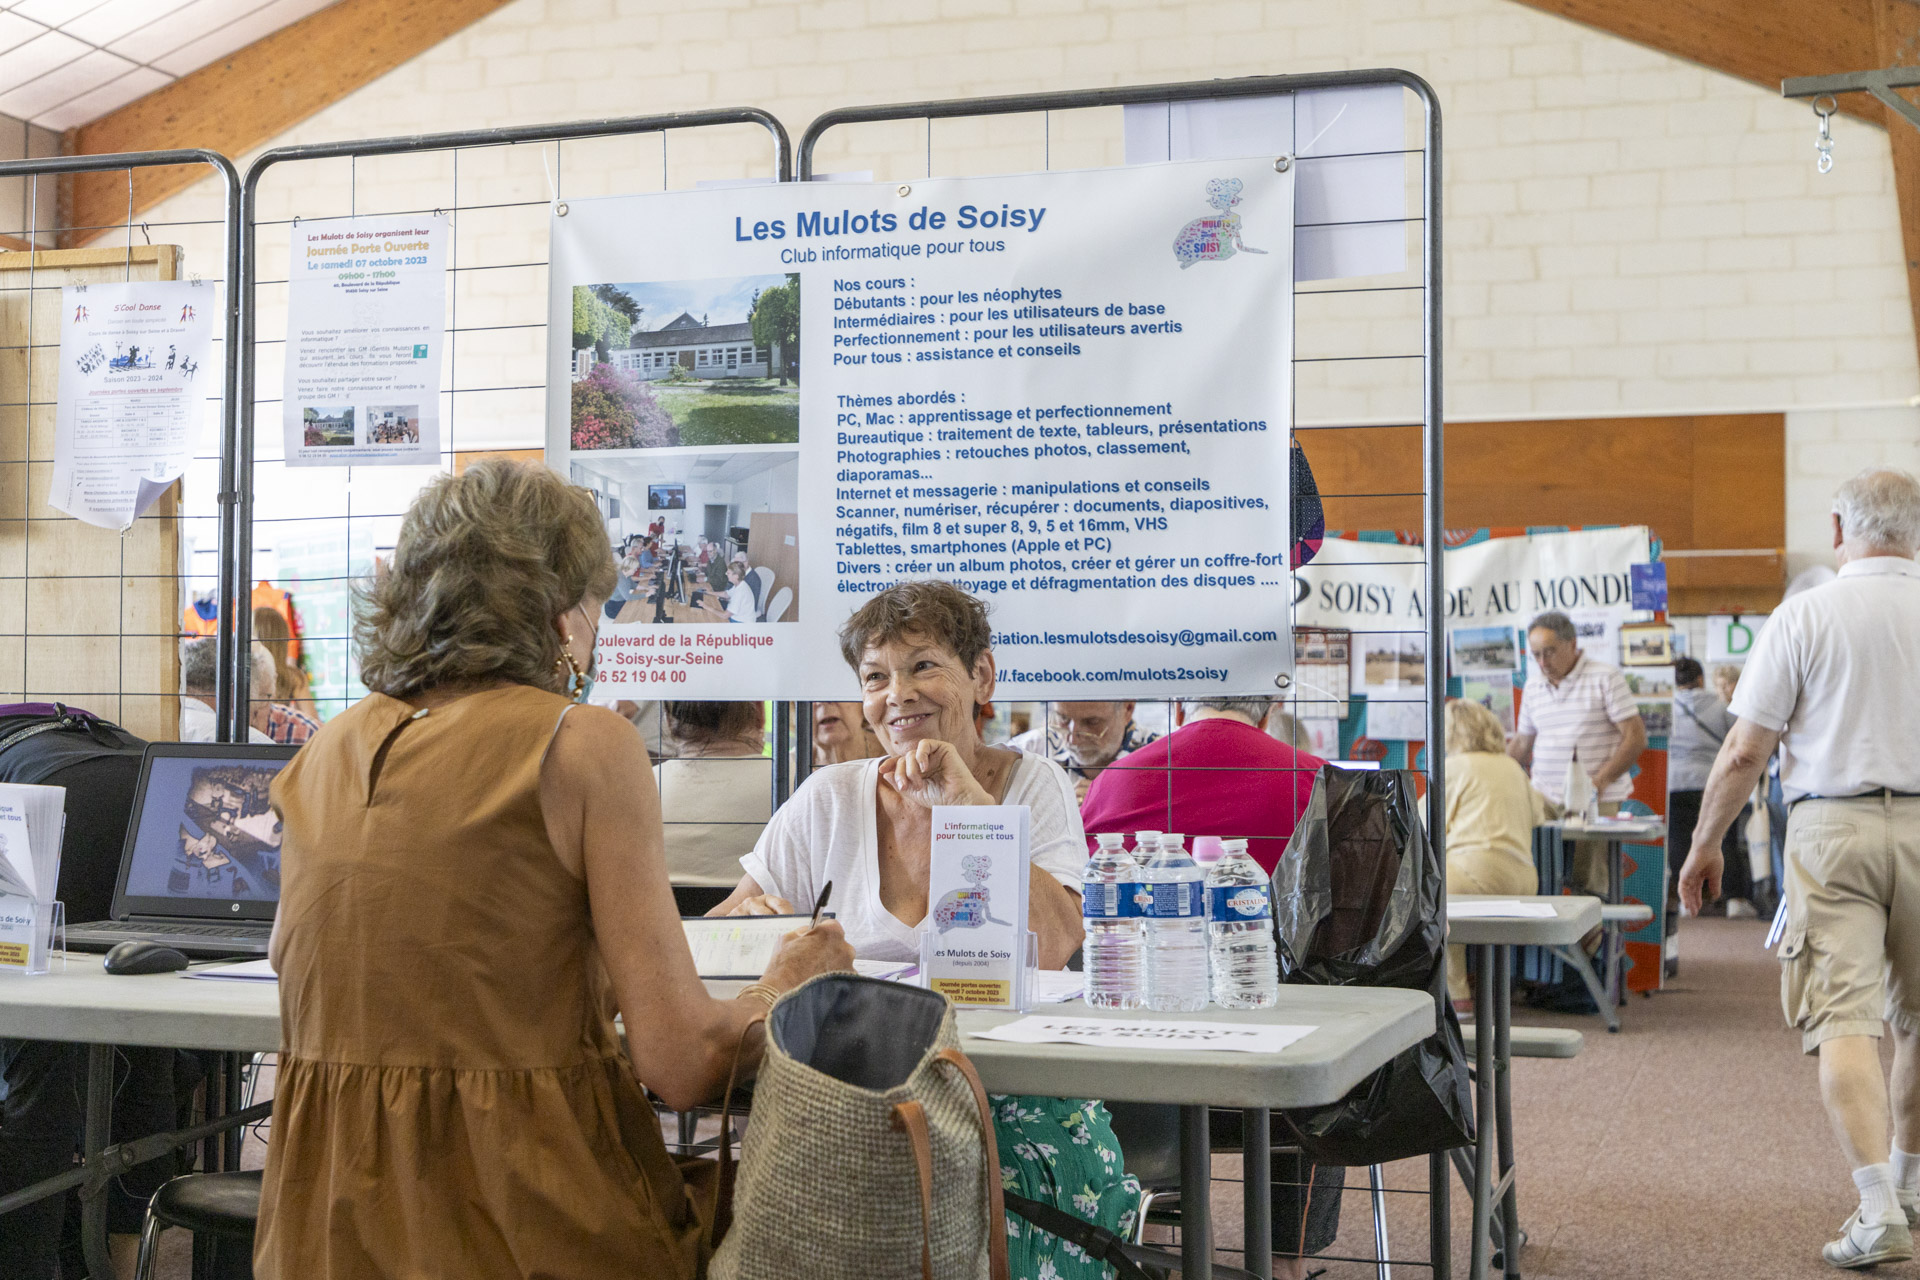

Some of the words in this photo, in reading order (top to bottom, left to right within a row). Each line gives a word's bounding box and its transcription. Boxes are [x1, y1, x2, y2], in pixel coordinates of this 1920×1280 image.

[736, 216, 786, 242] Les
[797, 209, 898, 238] Mulots
[908, 206, 946, 230] de
[957, 204, 1046, 232] Soisy
[1202, 220, 1231, 228] MULOTS
[321, 233, 344, 241] Mulots
[356, 231, 373, 239] Soisy
[375, 230, 412, 238] organisent
[307, 245, 348, 257] Journée
[351, 243, 381, 254] Porte
[384, 241, 430, 252] Ouverte
[780, 248, 817, 264] Club
[822, 242, 921, 261] informatique
[926, 242, 964, 258] pour
[969, 239, 1005, 252] tous
[1194, 242, 1220, 253] SOISY
[308, 261, 318, 270] Le
[321, 259, 353, 269] samedi
[369, 257, 403, 267] octobre
[405, 256, 427, 265] 2023
[338, 272, 365, 280] 09h00
[834, 279, 861, 292] Nos
[865, 278, 906, 290] cours
[834, 295, 906, 310] Débutants
[920, 294, 954, 309] pour
[958, 290, 978, 304] les
[984, 287, 1062, 304] néophytes
[834, 312, 935, 329] Intermédiaires
[950, 311, 984, 326] pour
[988, 308, 1008, 320] les
[1014, 305, 1100, 319] utilisateurs
[1104, 303, 1124, 316] de
[1128, 302, 1166, 316] base
[834, 329, 960, 347] Perfectionnement
[974, 328, 1008, 343] pour
[1012, 325, 1034, 338] les
[1040, 323, 1126, 337] utilisateurs
[1130, 320, 1183, 334] avertis
[834, 353, 867, 366] Pour
[871, 352, 902, 364] tous
[916, 348, 994, 362] assistance
[998, 345, 1013, 358] et
[1016, 342, 1081, 357] conseils
[836, 394, 893, 408] Thèmes
[897, 390, 956, 406] abordés
[837, 413, 861, 428] PC,
[866, 412, 894, 425] Mac
[908, 408, 1012, 426] apprentissage
[1016, 407, 1031, 420] et
[1036, 402, 1172, 422] perfectionnement
[837, 430, 924, 446] Bureautique
[937, 426, 1012, 441] traitement
[1016, 425, 1035, 438] de
[1039, 424, 1081, 438] texte,
[1086, 422, 1153, 436] tableurs,
[1159, 418, 1267, 437] présentations
[837, 448, 941, 465] Photographies
[955, 444, 1030, 459] retouches
[1034, 443, 1092, 460] photos,
[1096, 440, 1190, 455] classement,
[836, 468, 932, 484] diaporamas...
[836, 487, 892, 500] Internet
[895, 486, 909, 498] et
[913, 483, 998, 500] messagerie
[1012, 480, 1120, 497] manipulations
[1124, 480, 1140, 492] et
[1144, 478, 1210, 492] conseils
[836, 506, 899, 519] Scanner,
[904, 502, 981, 517] numériser,
[986, 500, 1060, 517] récupérer
[1074, 498, 1164, 513] documents,
[1170, 496, 1269, 513] diapositives,
[836, 523, 897, 540] négatifs,
[902, 522, 928, 536] film
[933, 522, 941, 535] 8
[946, 522, 960, 534] et
[964, 523, 1007, 537] super
[1011, 520, 1023, 535] 8,
[1028, 520, 1041, 534] 9,
[1046, 519, 1055, 532] 5
[1059, 520, 1074, 532] et
[1079, 518, 1130, 533] 16mm,
[1134, 516, 1168, 530] VHS
[835, 542, 906, 556] Tablettes,
[910, 540, 1007, 556] smartphones
[1012, 538, 1060, 555] (Apple
[1064, 538, 1080, 551] et
[1084, 537, 1112, 553] PC)
[836, 561, 881, 574] Divers
[895, 560, 932, 573] créer
[937, 562, 954, 572] un
[960, 559, 1004, 572] album
[1010, 558, 1066, 574] photos,
[1072, 556, 1112, 570] créer
[1116, 556, 1130, 570] et
[1135, 555, 1176, 572] gérer
[1180, 557, 1200, 568] un
[1204, 552, 1283, 568] coffre-fort
[1011, 577, 1026, 590] et
[1030, 575, 1156, 592] défragmentation
[1161, 574, 1189, 588] des
[1194, 573, 1256, 589] disques
[1320, 580, 1395, 615] SOISY
[1408, 587, 1474, 618] ADE
[1485, 581, 1522, 614] AU
[598, 634, 655, 647] oulevard
[659, 634, 675, 646] de
[680, 634, 692, 647] la
[696, 634, 774, 648] République
[990, 628, 1277, 646] ciation.lesmulotsdesoisy@gmail.com
[1727, 622, 1754, 654] D
[616, 652, 724, 668] Soisy-sur-Seine
[611, 670, 627, 682] 52
[632, 670, 646, 682] 19
[650, 670, 666, 682] 04
[670, 670, 686, 682] 00
[944, 823, 1004, 832] L'informatique
[936, 833, 955, 841] pour
[1227, 897, 1267, 907] CRISTALINE
[947, 949, 976, 957] Mulots
[978, 950, 988, 958] de
[990, 950, 1011, 959] Soisy
